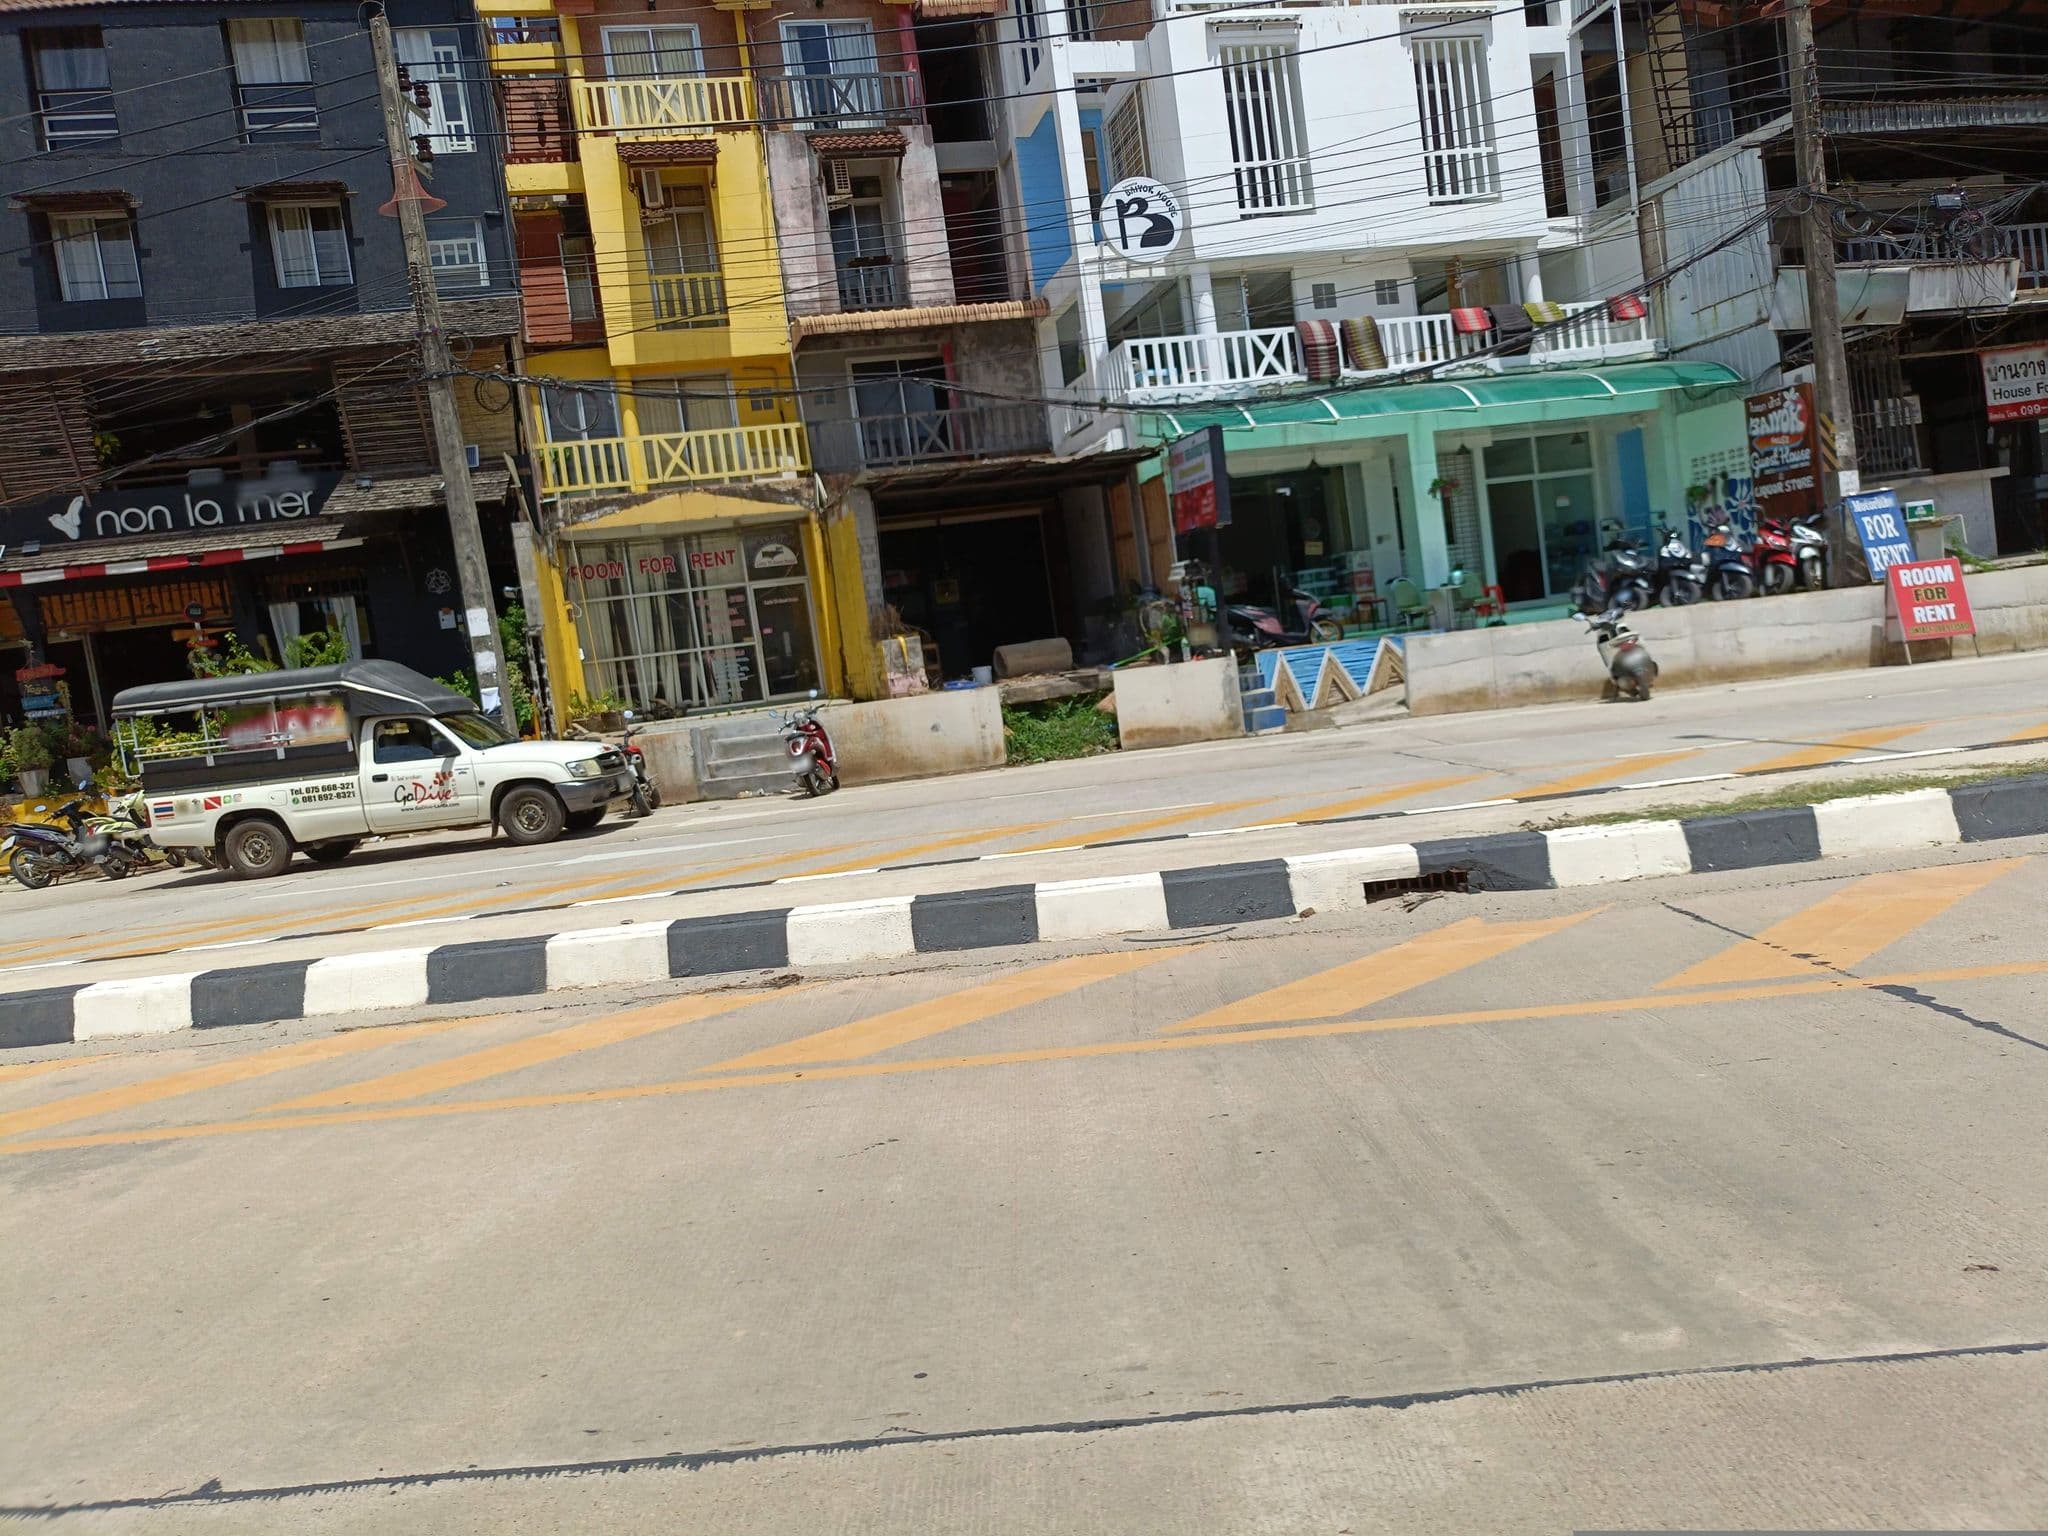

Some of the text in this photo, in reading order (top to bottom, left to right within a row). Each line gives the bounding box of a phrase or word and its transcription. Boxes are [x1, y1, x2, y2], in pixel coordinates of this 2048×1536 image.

[1992, 386, 2031, 400] House
[1784, 475, 1815, 493] STORE
[96, 490, 314, 536] non la mer
[1861, 513, 1900, 541] FOR
[569, 560, 625, 581] ROOM
[639, 555, 677, 575] FOR
[690, 549, 737, 570] RENT
[1867, 543, 1910, 572] RENT
[1898, 564, 1956, 588] ROOM
[1913, 586, 1948, 601] FOR
[1912, 603, 1957, 624] RENT
[302, 795, 316, 803] 081
[305, 786, 320, 794] 075
